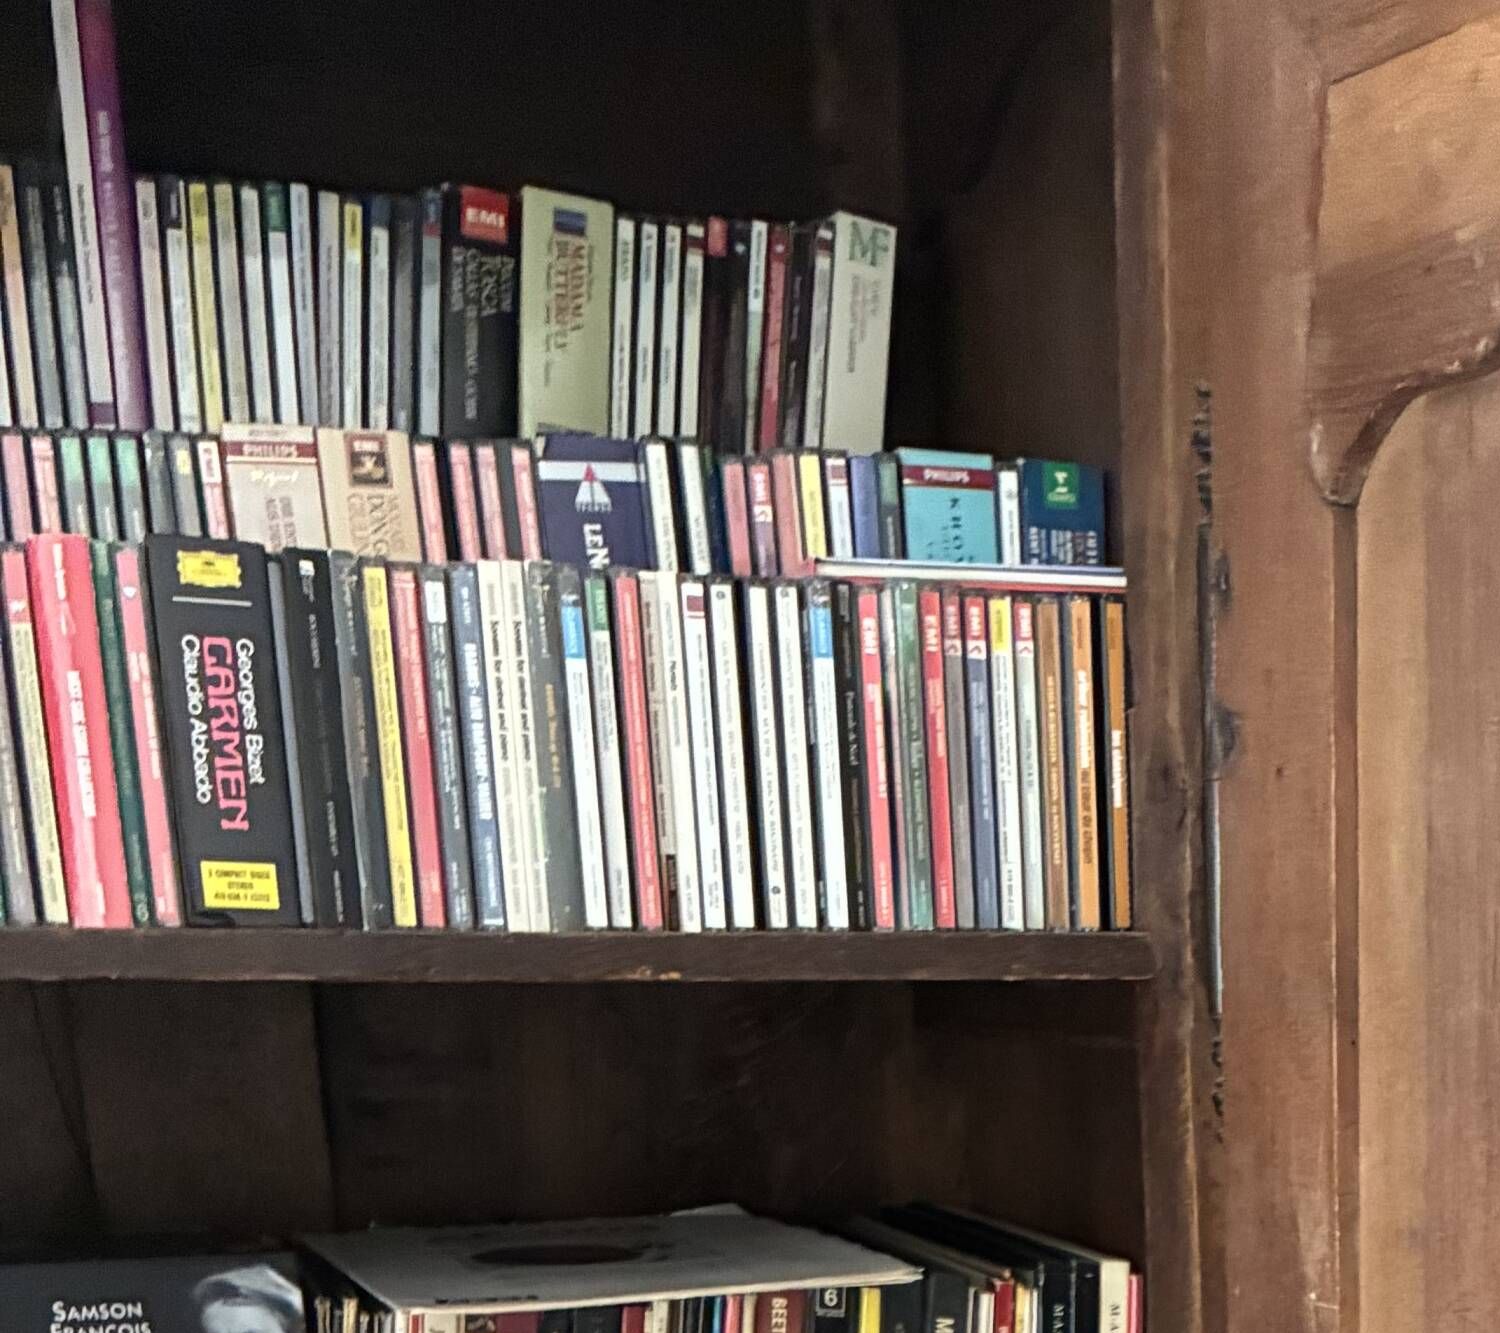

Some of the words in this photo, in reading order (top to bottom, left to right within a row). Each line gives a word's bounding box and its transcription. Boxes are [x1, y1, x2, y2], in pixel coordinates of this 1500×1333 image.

[465, 209, 506, 229] EMI
[925, 615, 939, 651] EMI
[181, 634, 203, 714] Claudio
[235, 638, 257, 729] Georges
[247, 734, 265, 785] Bizet
[190, 718, 213, 804] Abbado
[204, 635, 249, 831] CARMEN
[51, 1300, 143, 1322] SAMSON
